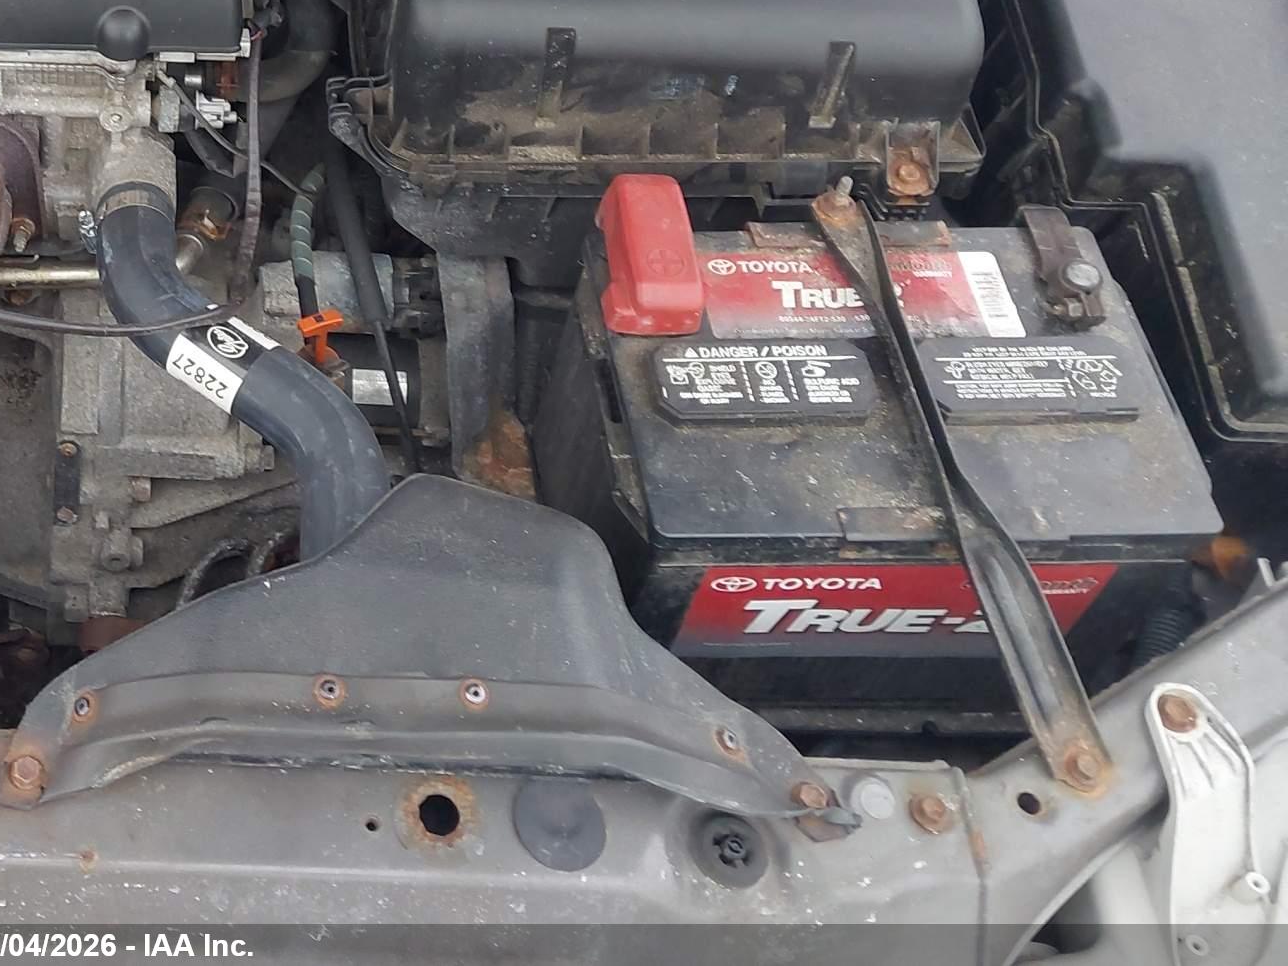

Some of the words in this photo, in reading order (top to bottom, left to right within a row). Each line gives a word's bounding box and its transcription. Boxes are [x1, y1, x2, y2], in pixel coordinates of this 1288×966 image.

[738, 260, 812, 275] TOYOTA
[699, 346, 759, 358] DANGER
[771, 345, 828, 356] POISON
[171, 353, 228, 399] 22827
[763, 576, 883, 591] TOYOTA
